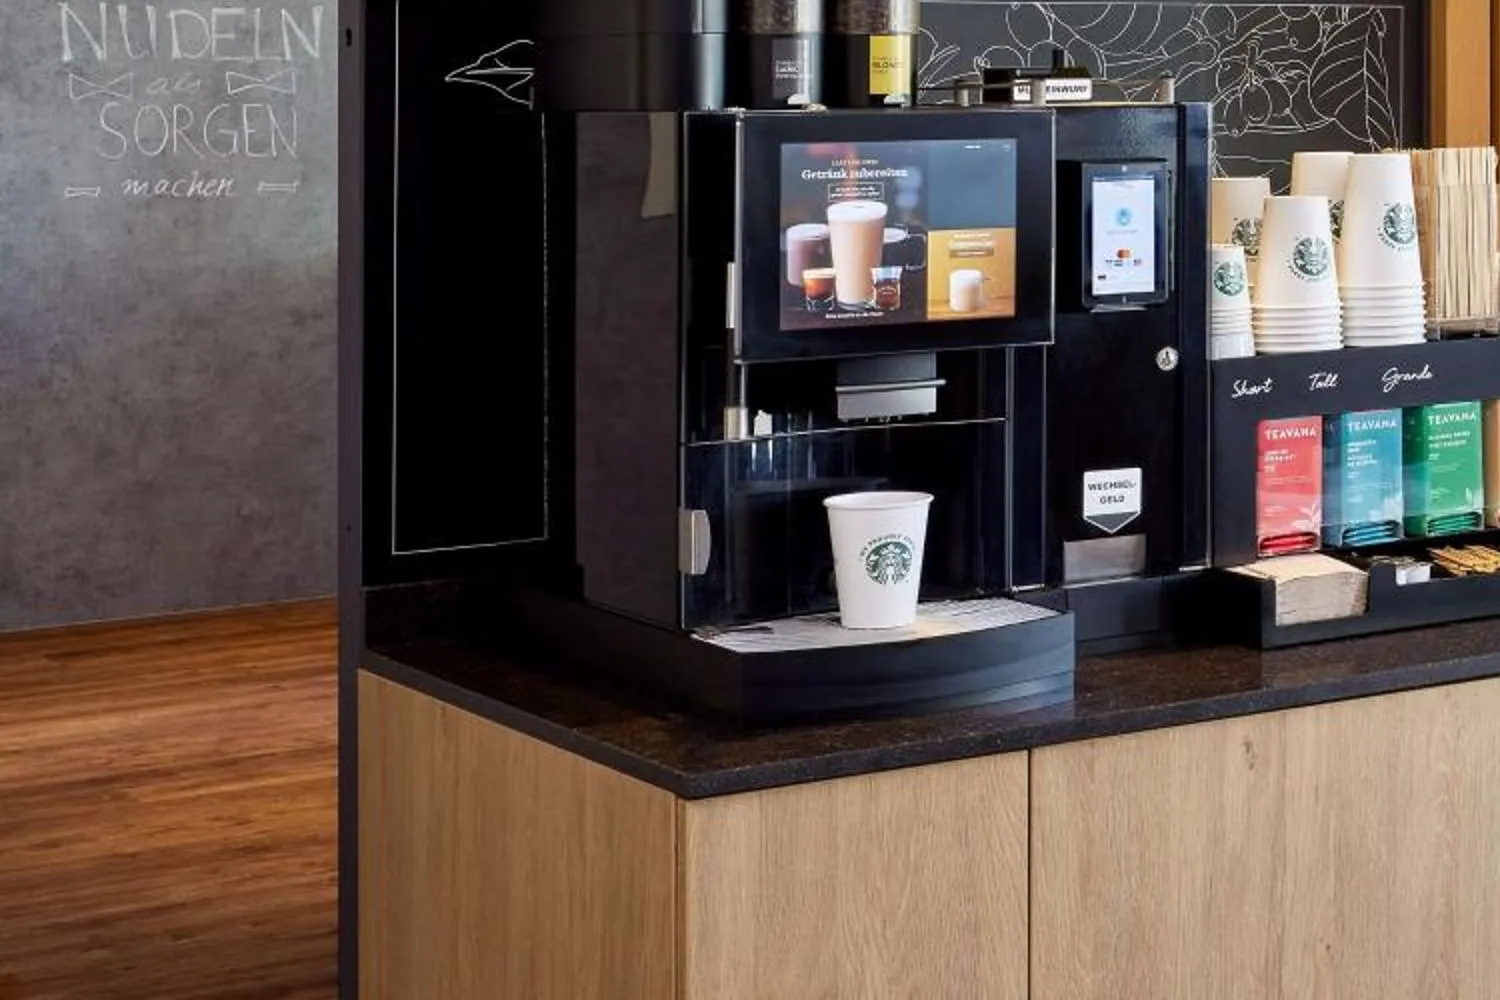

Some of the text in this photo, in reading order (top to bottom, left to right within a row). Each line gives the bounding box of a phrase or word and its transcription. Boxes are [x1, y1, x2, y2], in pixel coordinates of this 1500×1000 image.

[58, 1, 324, 63] NUDELN
[96, 102, 298, 159] SORGEN
[121, 170, 240, 199] machen
[1231, 363, 1434, 398] Short Tall Grande
[1099, 495, 1126, 505] GELD
